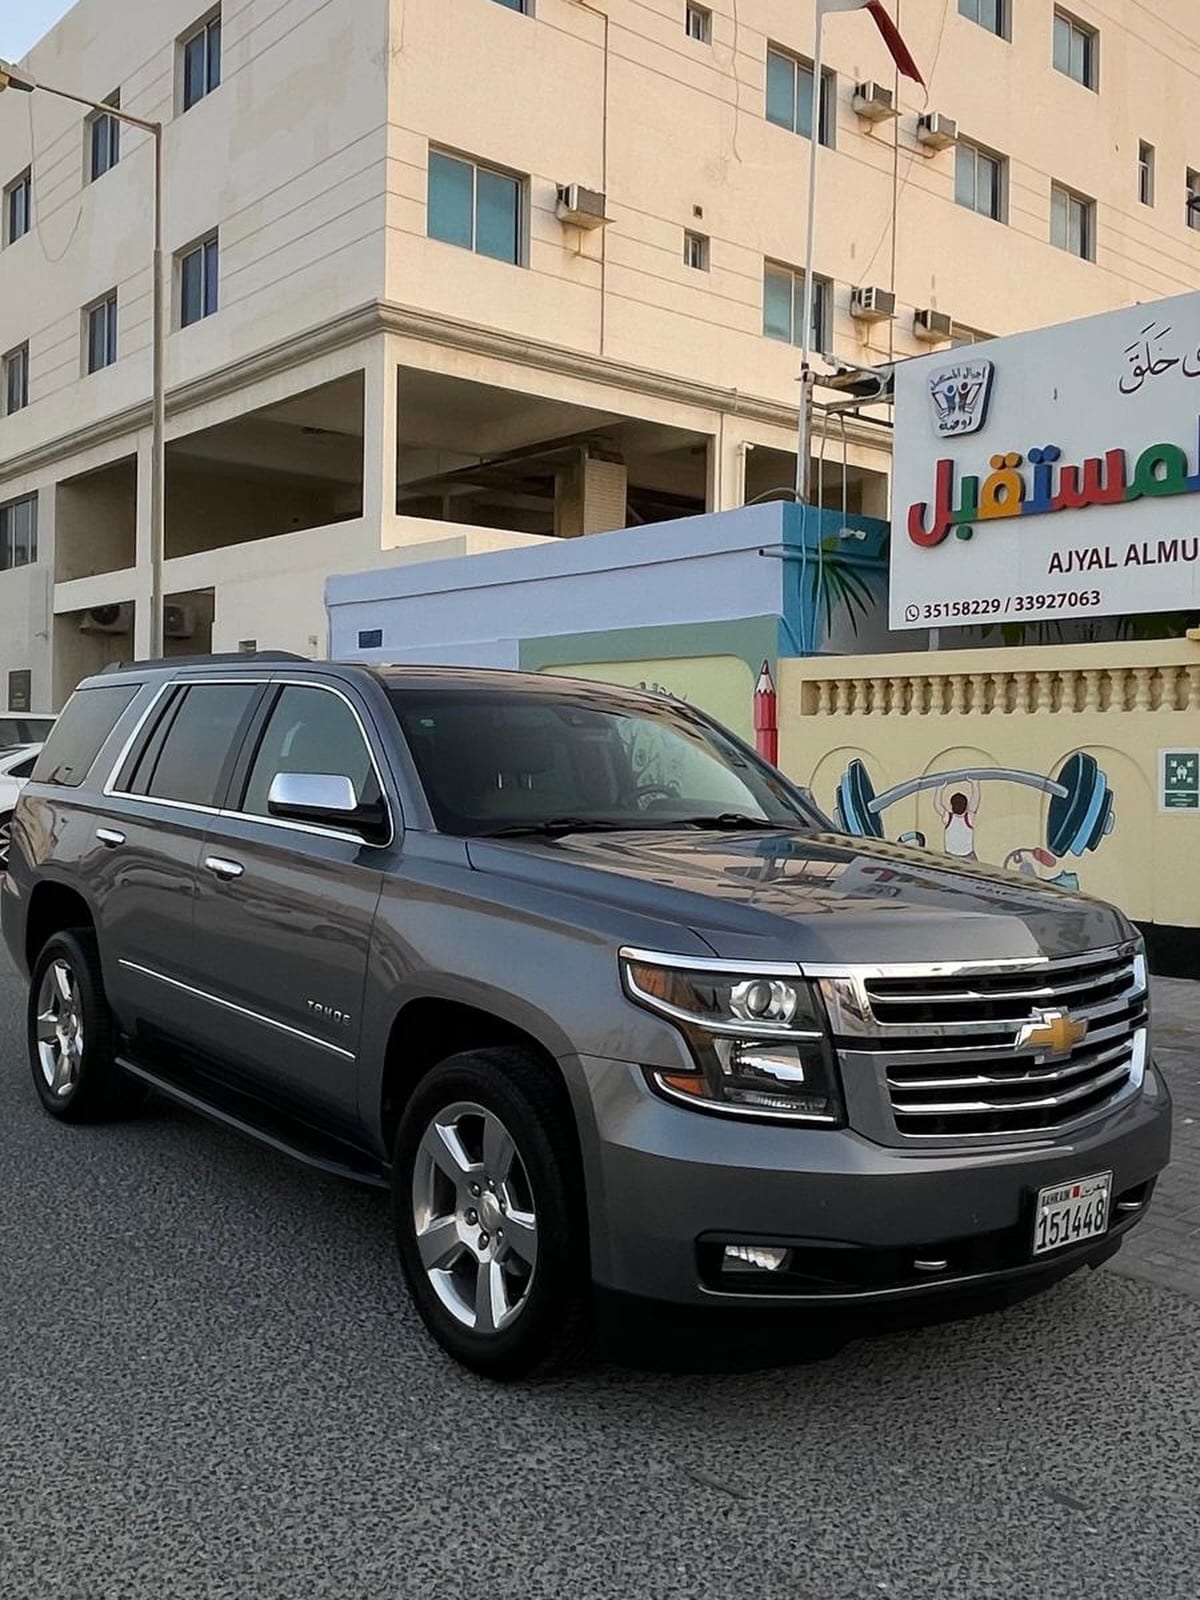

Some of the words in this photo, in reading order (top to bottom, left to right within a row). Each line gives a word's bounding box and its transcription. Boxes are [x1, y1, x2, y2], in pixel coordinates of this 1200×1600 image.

[907, 414, 1200, 547] مستقبل
[1048, 546, 1117, 574] AJYAL
[1124, 537, 1199, 567] ALMU
[923, 599, 1000, 618] 35158229
[1015, 590, 1101, 611] 33927063
[1037, 1199, 1104, 1250] 151448
